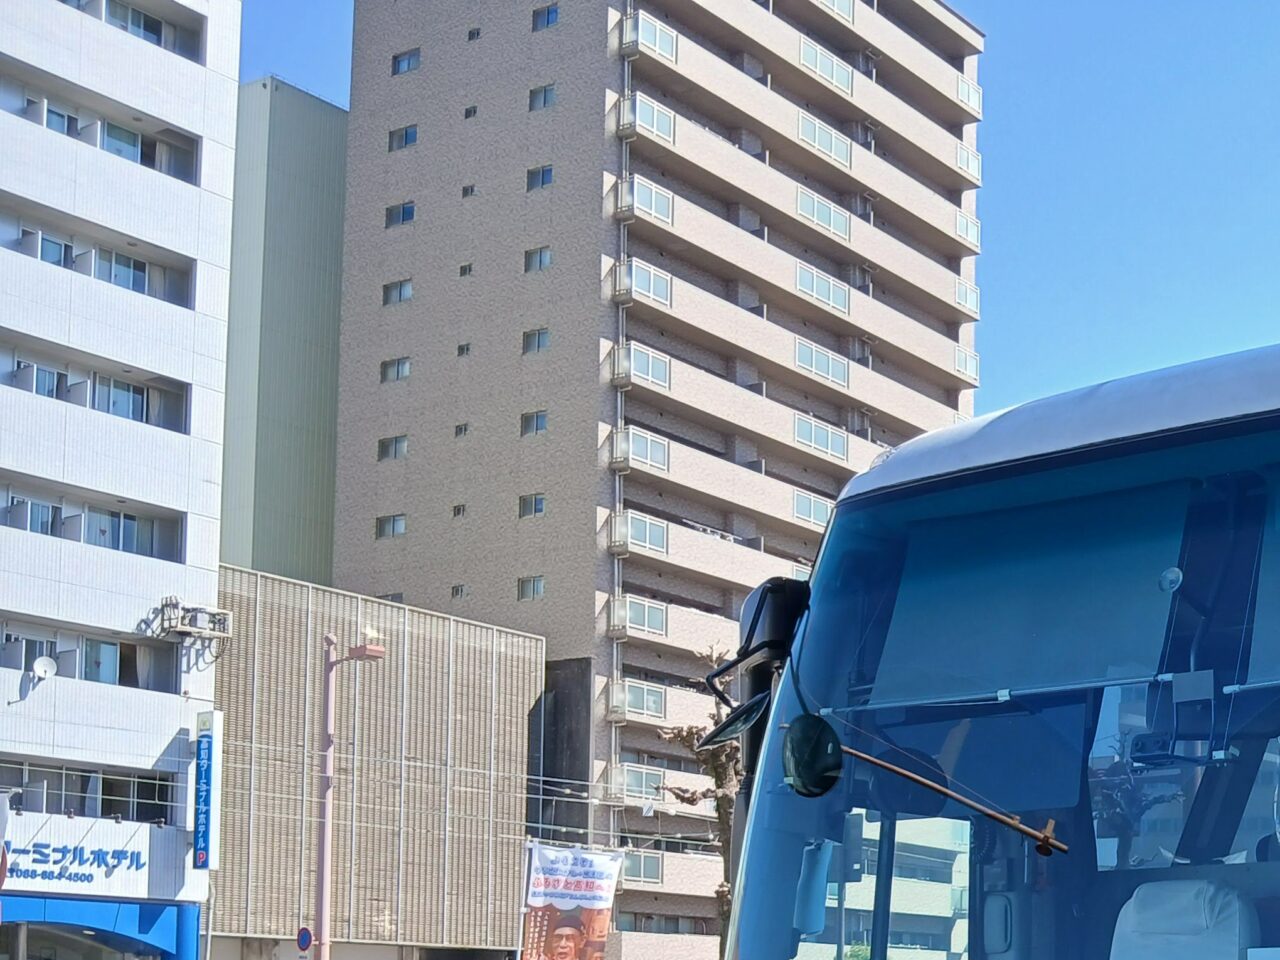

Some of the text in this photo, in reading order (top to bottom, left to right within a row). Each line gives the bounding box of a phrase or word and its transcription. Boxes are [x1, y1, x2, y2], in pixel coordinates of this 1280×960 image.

[197, 738, 210, 849] 高知ターミナルホテル
[196, 851, 206, 865] P
